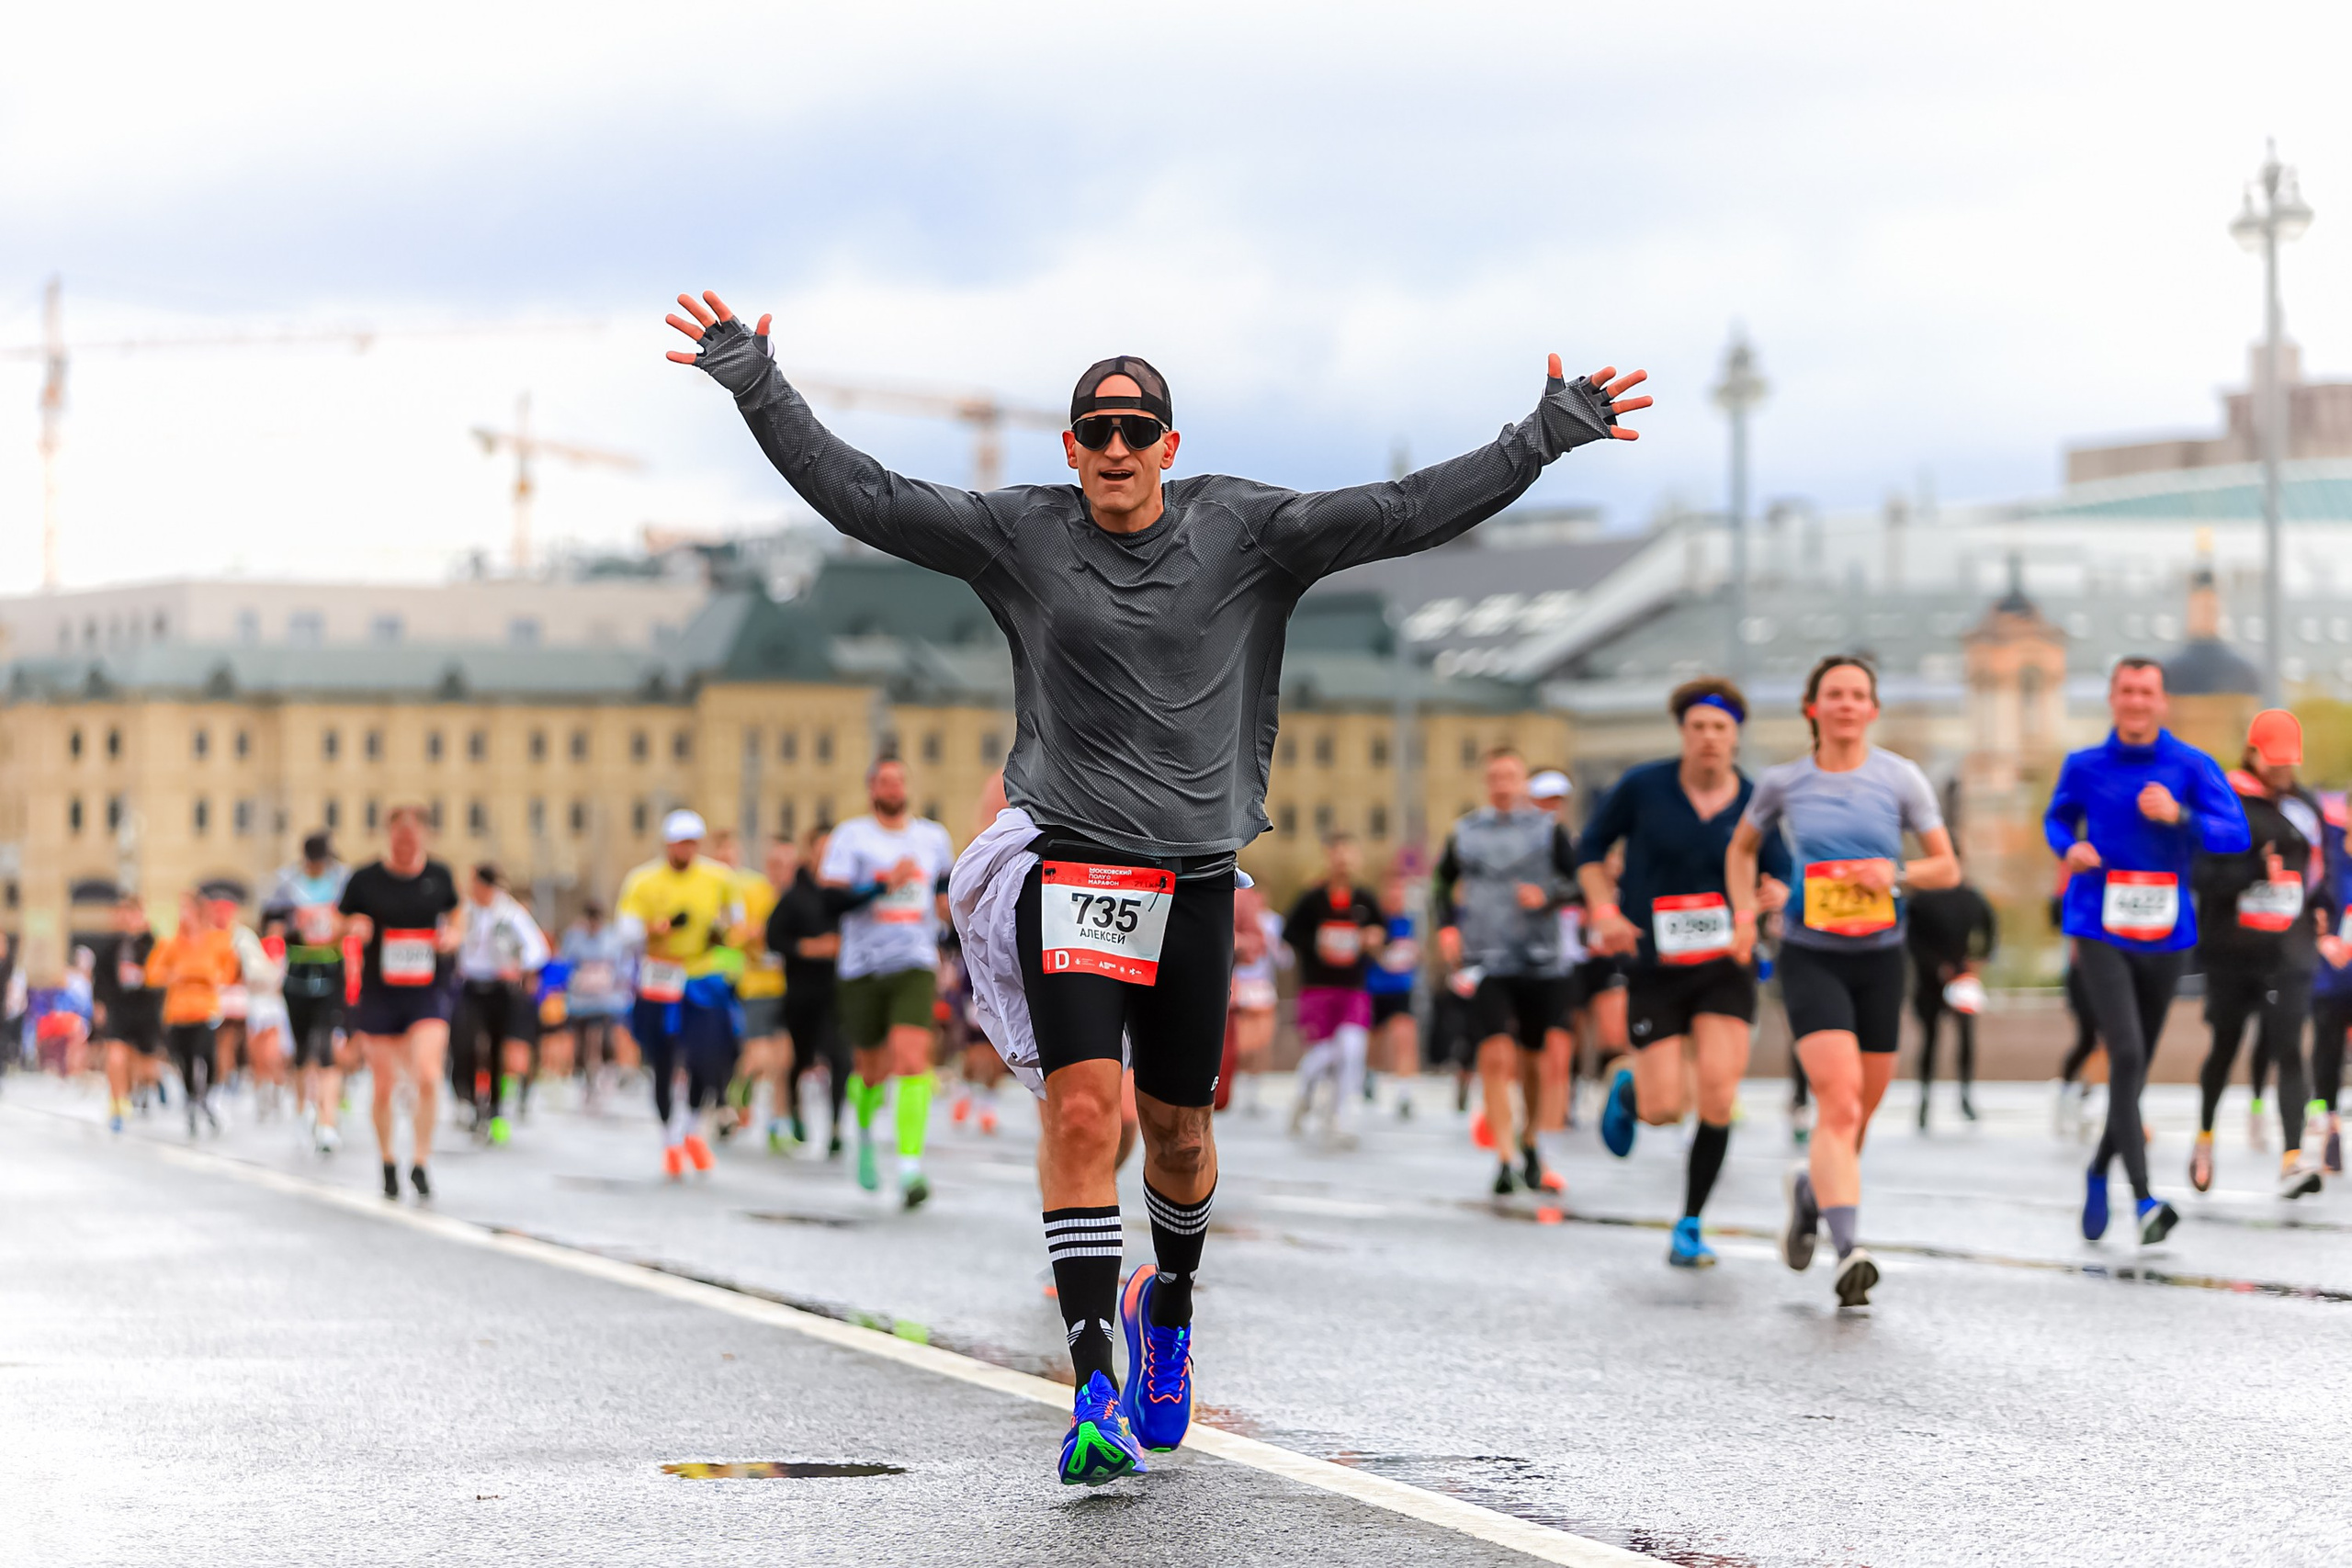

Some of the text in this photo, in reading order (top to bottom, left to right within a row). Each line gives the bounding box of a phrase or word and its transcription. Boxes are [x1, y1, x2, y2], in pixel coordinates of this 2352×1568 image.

[1089, 867, 1132, 876] МОСКОВСКИЙ
[1071, 892, 1142, 933] 735
[1080, 928, 1126, 944] АЛЕКСЕЙ
[1054, 950, 1070, 970] D
